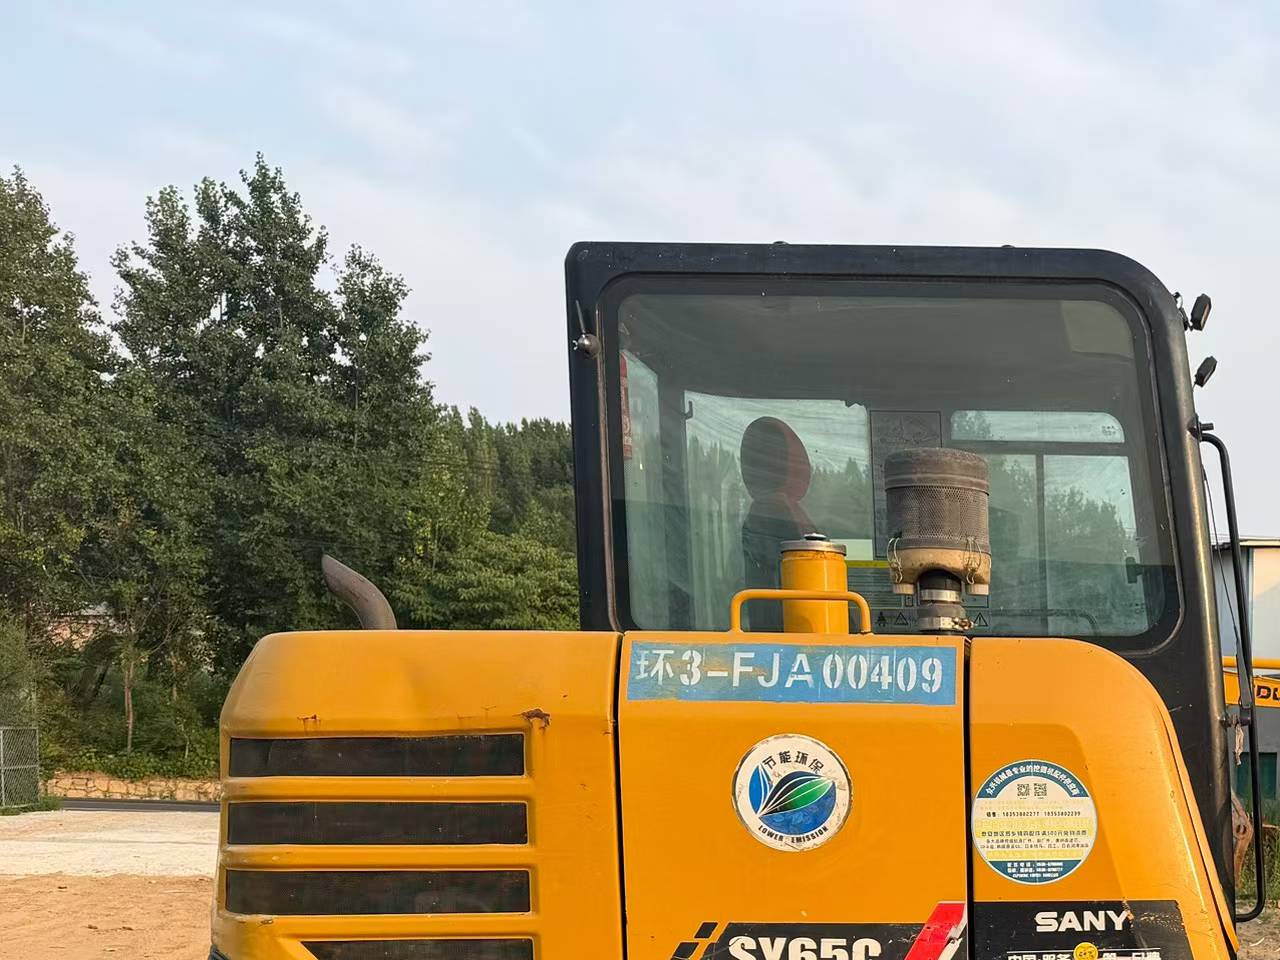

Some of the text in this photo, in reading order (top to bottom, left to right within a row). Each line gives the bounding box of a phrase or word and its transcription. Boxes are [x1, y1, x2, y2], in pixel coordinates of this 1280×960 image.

[762, 750, 825, 774] 节能环保
[758, 825, 829, 843] LOWER EMISSION
[1035, 910, 1129, 932] SANY
